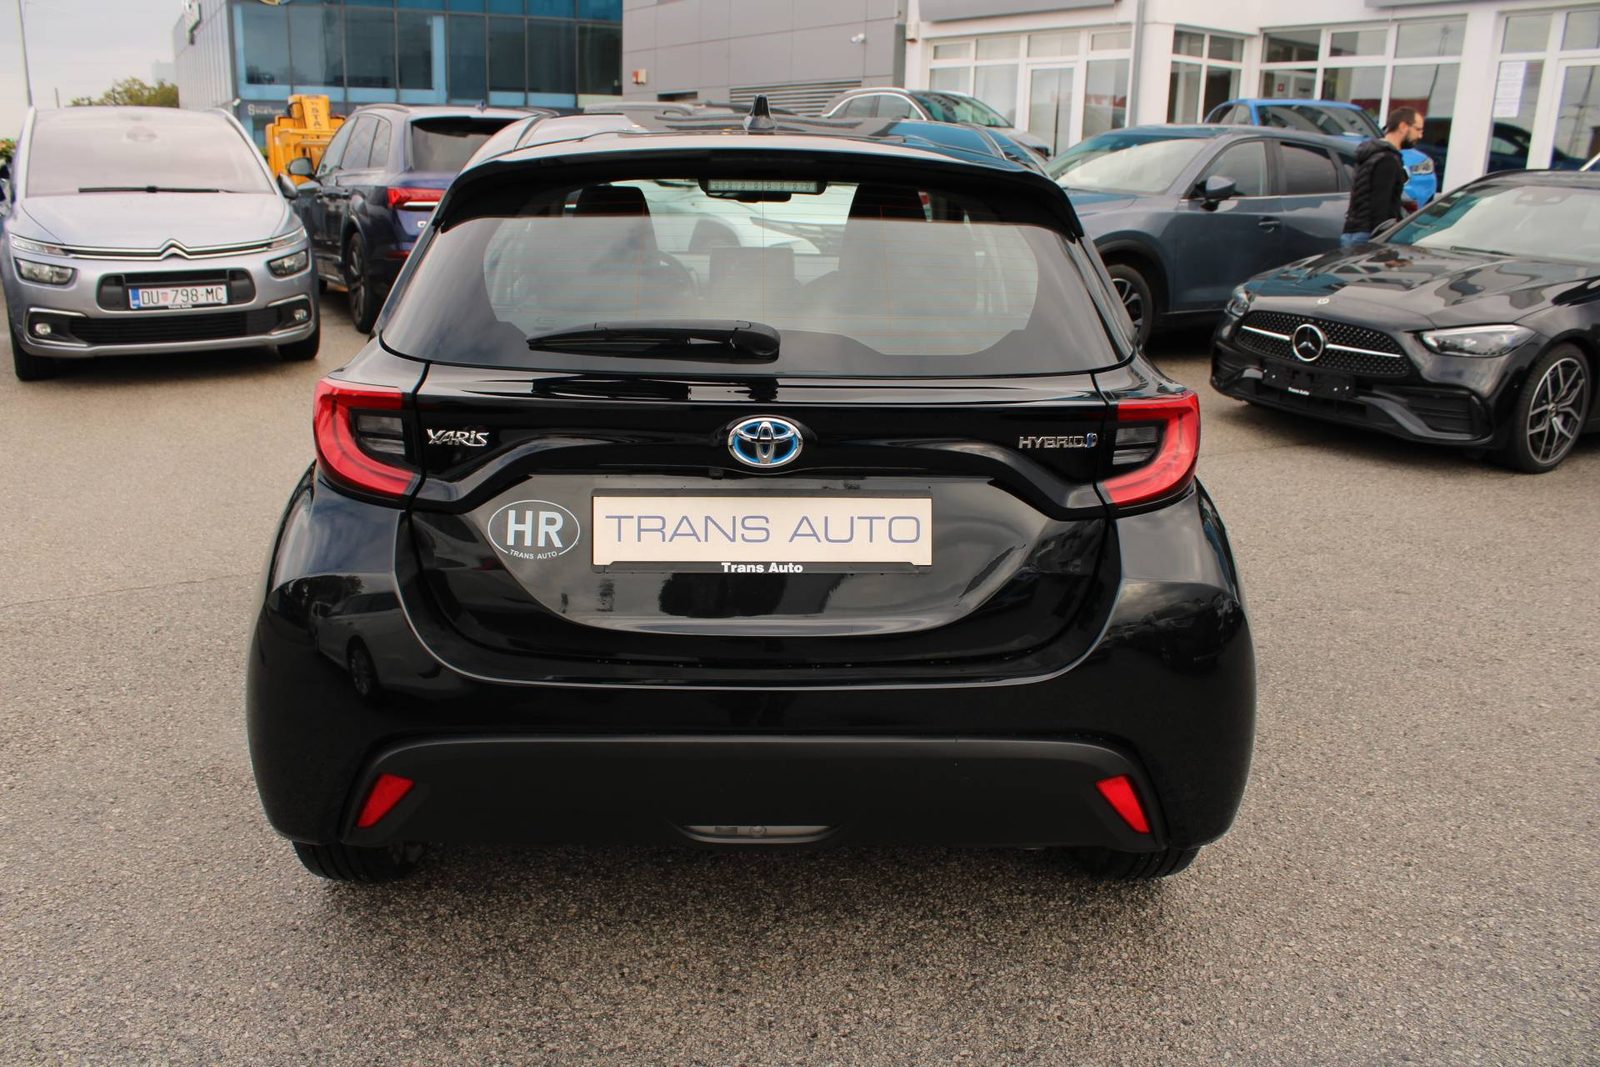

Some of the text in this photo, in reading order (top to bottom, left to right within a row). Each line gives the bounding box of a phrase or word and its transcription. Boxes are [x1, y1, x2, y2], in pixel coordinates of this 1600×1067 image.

[140, 290, 160, 306] DU
[426, 428, 490, 447] YARIS
[1018, 435, 1085, 449] HYBRID
[506, 509, 563, 548] HR
[604, 515, 921, 543] TRANS AUTO
[510, 548, 558, 560] TRANS AUTO
[721, 562, 804, 574] Trans Auto
